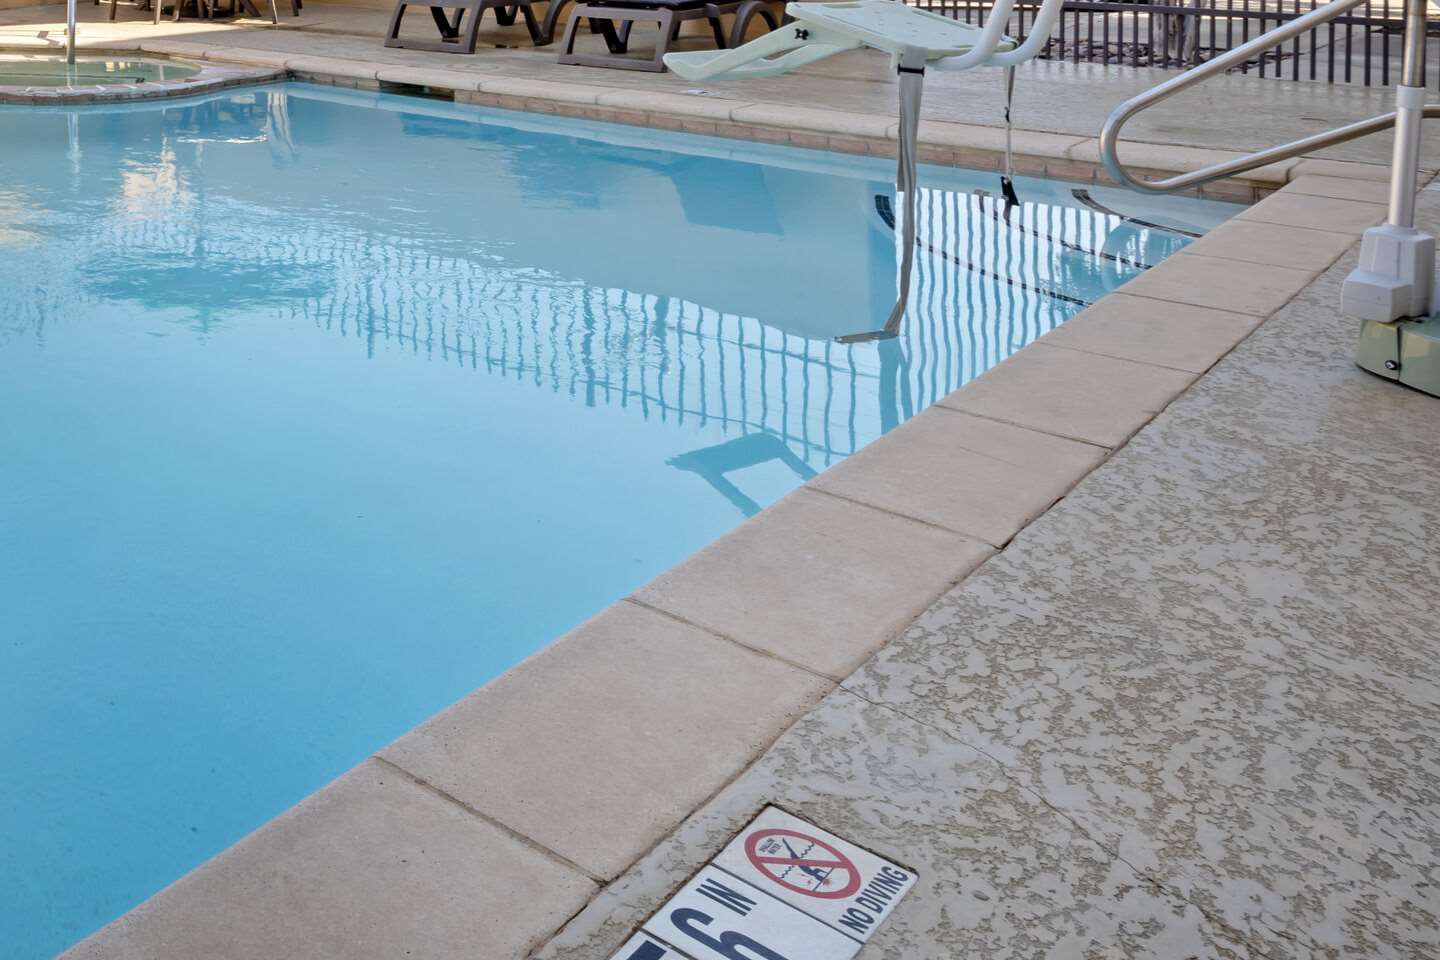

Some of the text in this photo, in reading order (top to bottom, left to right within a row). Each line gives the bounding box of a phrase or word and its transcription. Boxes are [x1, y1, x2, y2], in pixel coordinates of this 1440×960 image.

[695, 877, 758, 917] IN
[838, 866, 909, 935] NO DIVING
